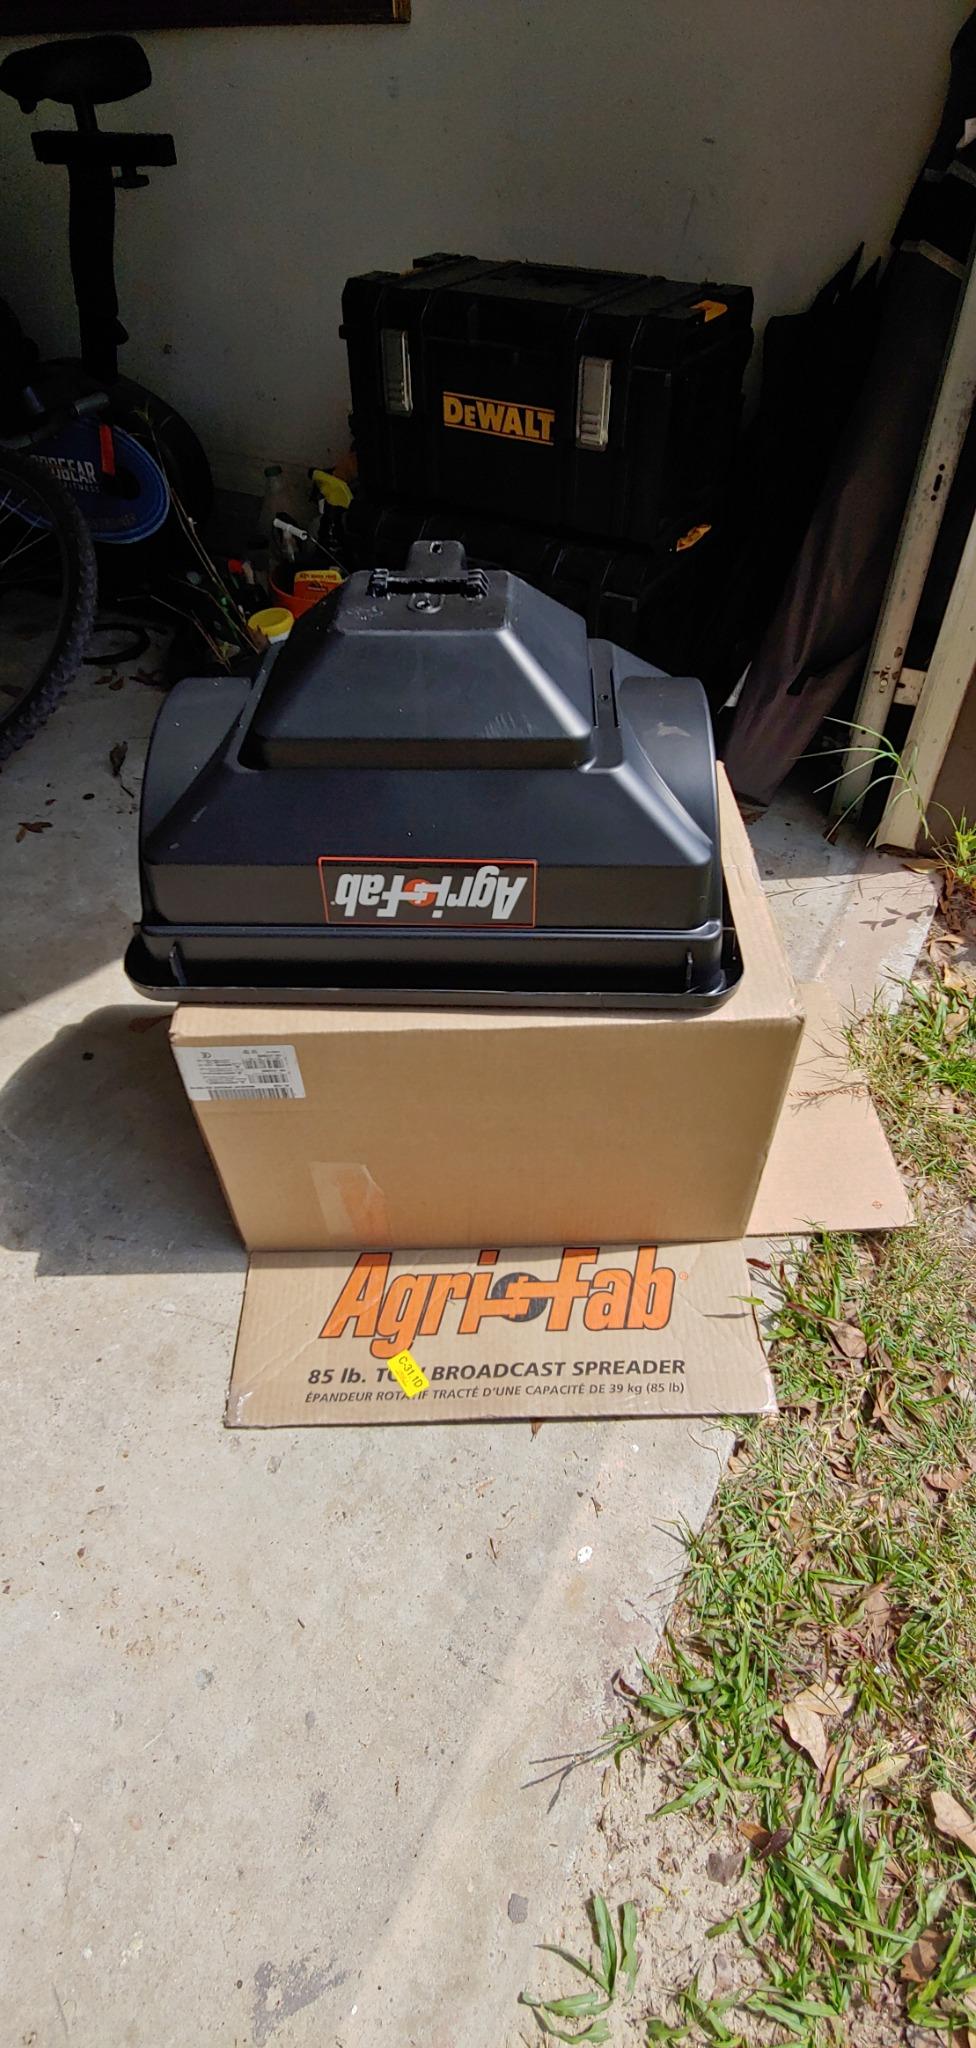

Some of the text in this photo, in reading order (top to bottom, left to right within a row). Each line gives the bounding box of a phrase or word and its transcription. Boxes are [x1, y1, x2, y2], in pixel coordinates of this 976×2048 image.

[29, 454, 97, 484] OGEAR
[307, 1369, 335, 1384] 85
[341, 1367, 366, 1383] lb.
[431, 1361, 566, 1381] BROADCAST
[571, 1360, 686, 1377] SPREADER
[304, 1382, 685, 1404] ÉPANDEUR ROTAIF TRACTÉ D'UNE CAPACITÉ DE 39 kg (85 lb)
